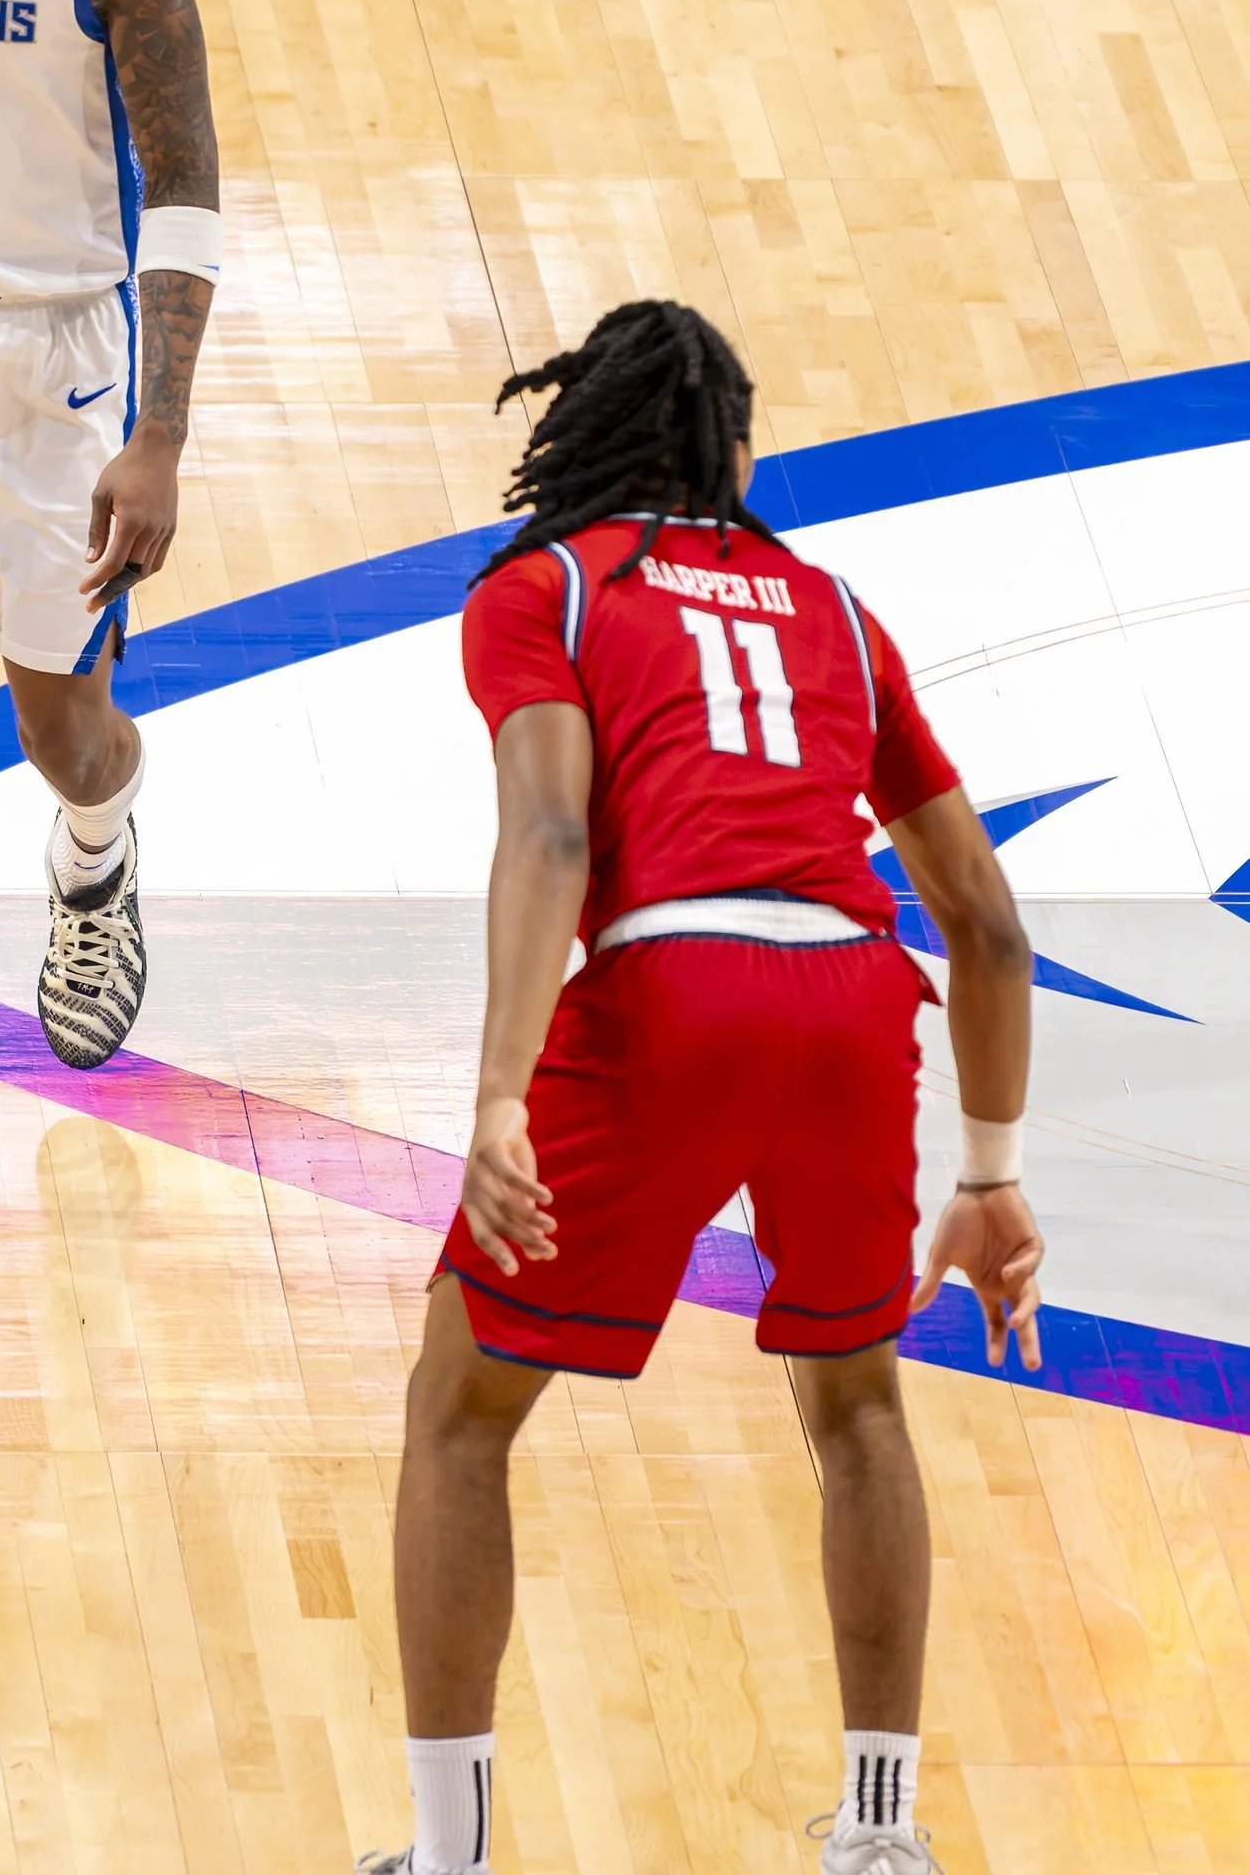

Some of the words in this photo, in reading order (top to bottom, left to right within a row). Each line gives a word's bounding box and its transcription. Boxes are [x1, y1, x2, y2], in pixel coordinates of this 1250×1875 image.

[639, 555, 758, 610] HARPER
[753, 576, 796, 616] III
[679, 605, 802, 769] 11
